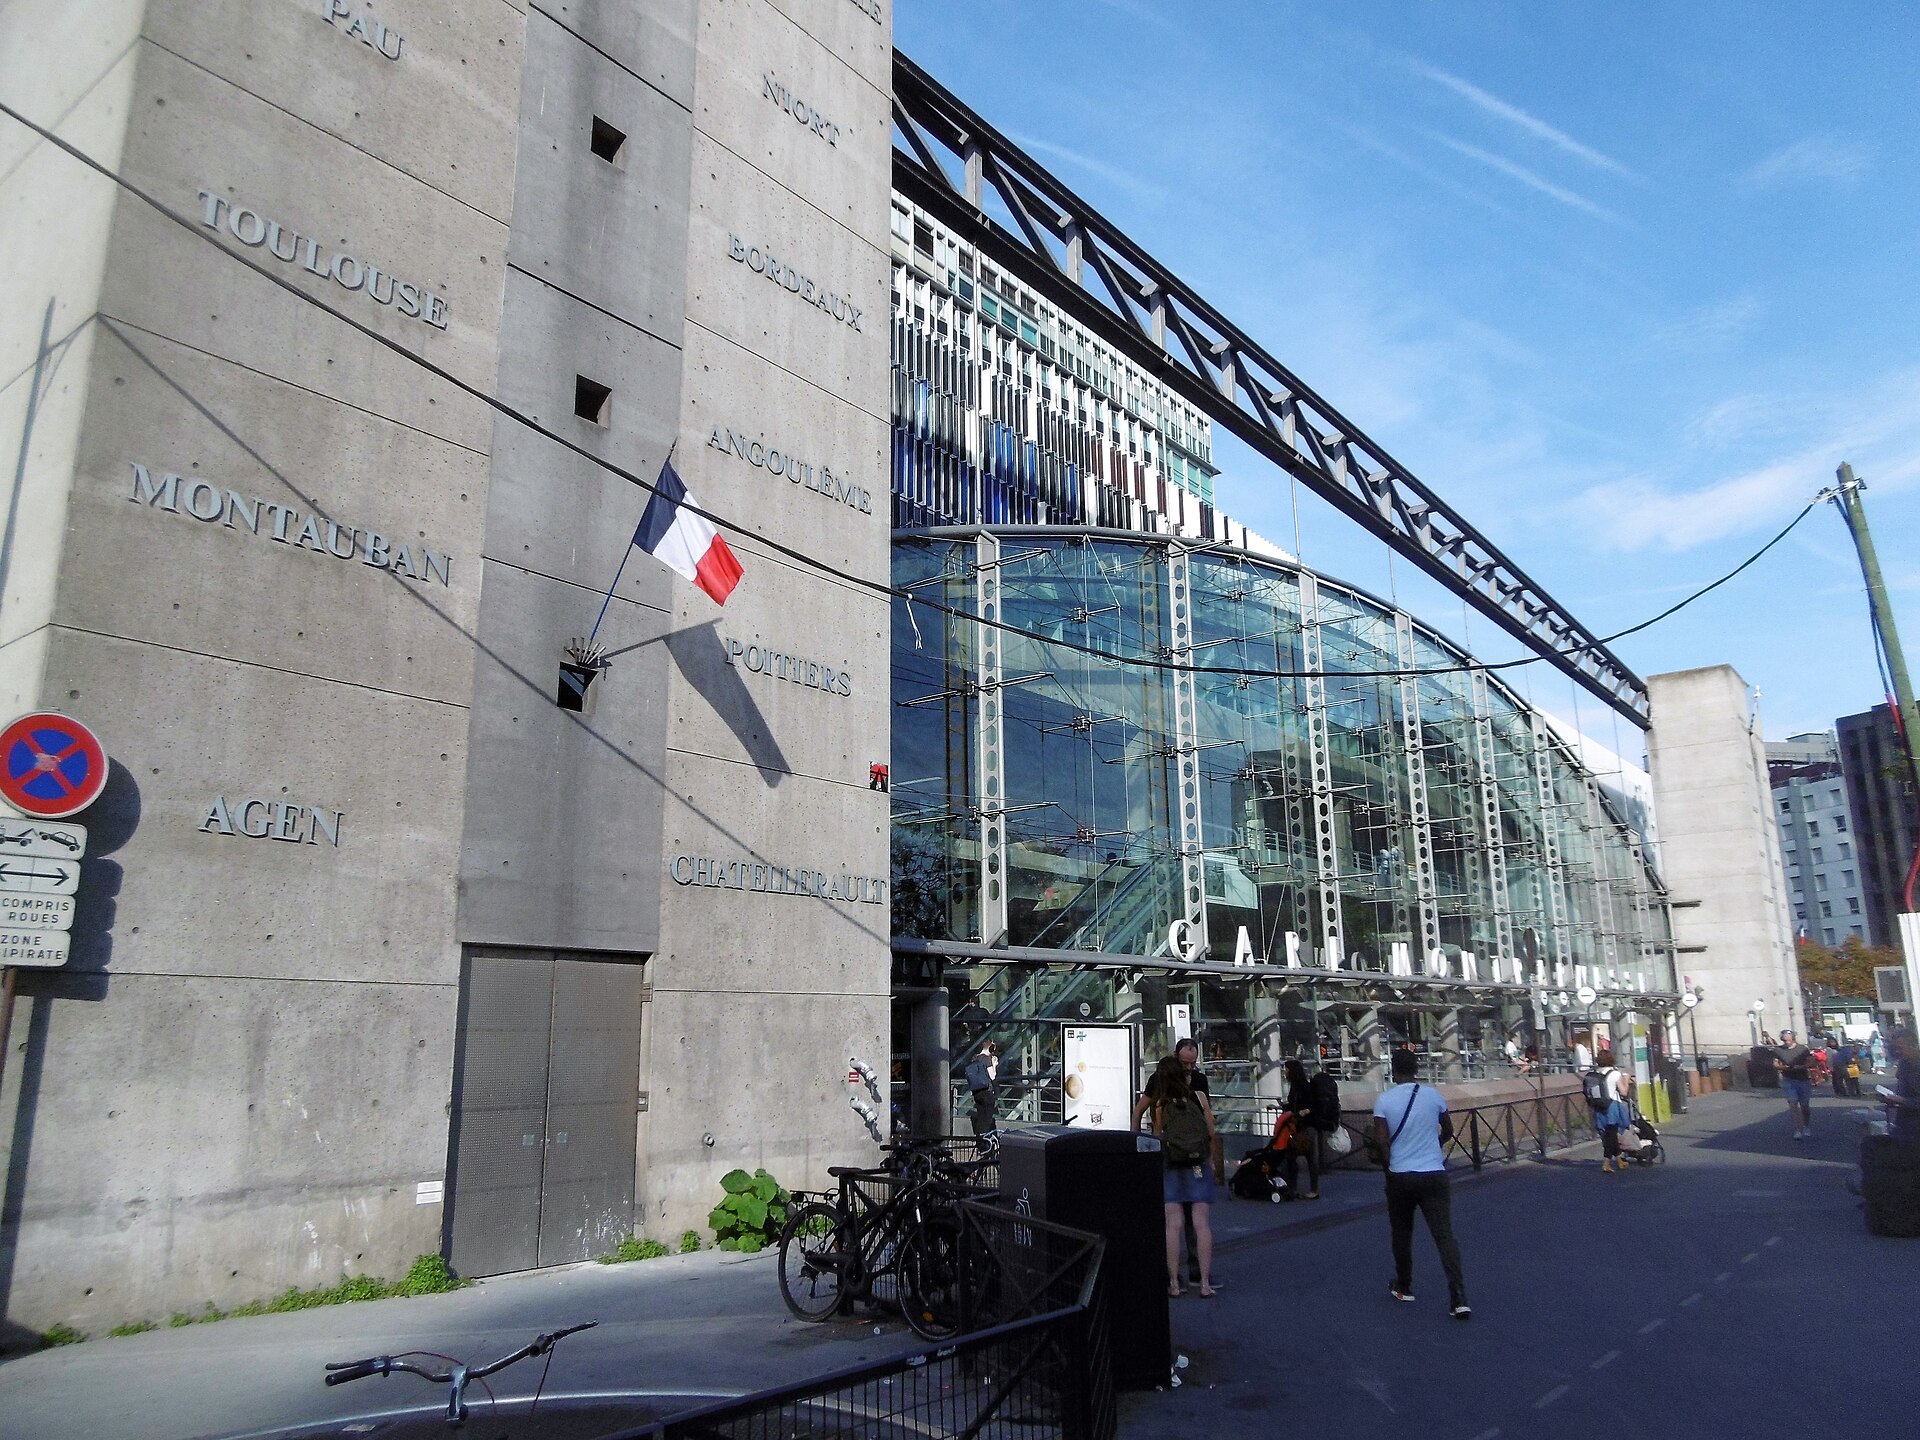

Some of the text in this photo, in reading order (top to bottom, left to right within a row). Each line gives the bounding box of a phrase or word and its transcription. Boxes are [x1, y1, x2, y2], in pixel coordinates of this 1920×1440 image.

[321, 0, 404, 61] PAU
[762, 72, 841, 149] NIORT
[198, 187, 449, 330] TOULOUSE
[728, 231, 863, 334] BORDEAUX
[707, 424, 873, 516] ANGOULÊME
[128, 461, 454, 588] MONTAUBAN
[725, 637, 852, 698] POITIERS
[197, 794, 346, 848] AGEN
[2, 898, 69, 911] COMPRIS
[671, 854, 887, 905] CHATELLERAULT
[1, 934, 42, 945] ZONE
[8, 911, 59, 923] ROUES
[1168, 918, 1344, 972] GARE
